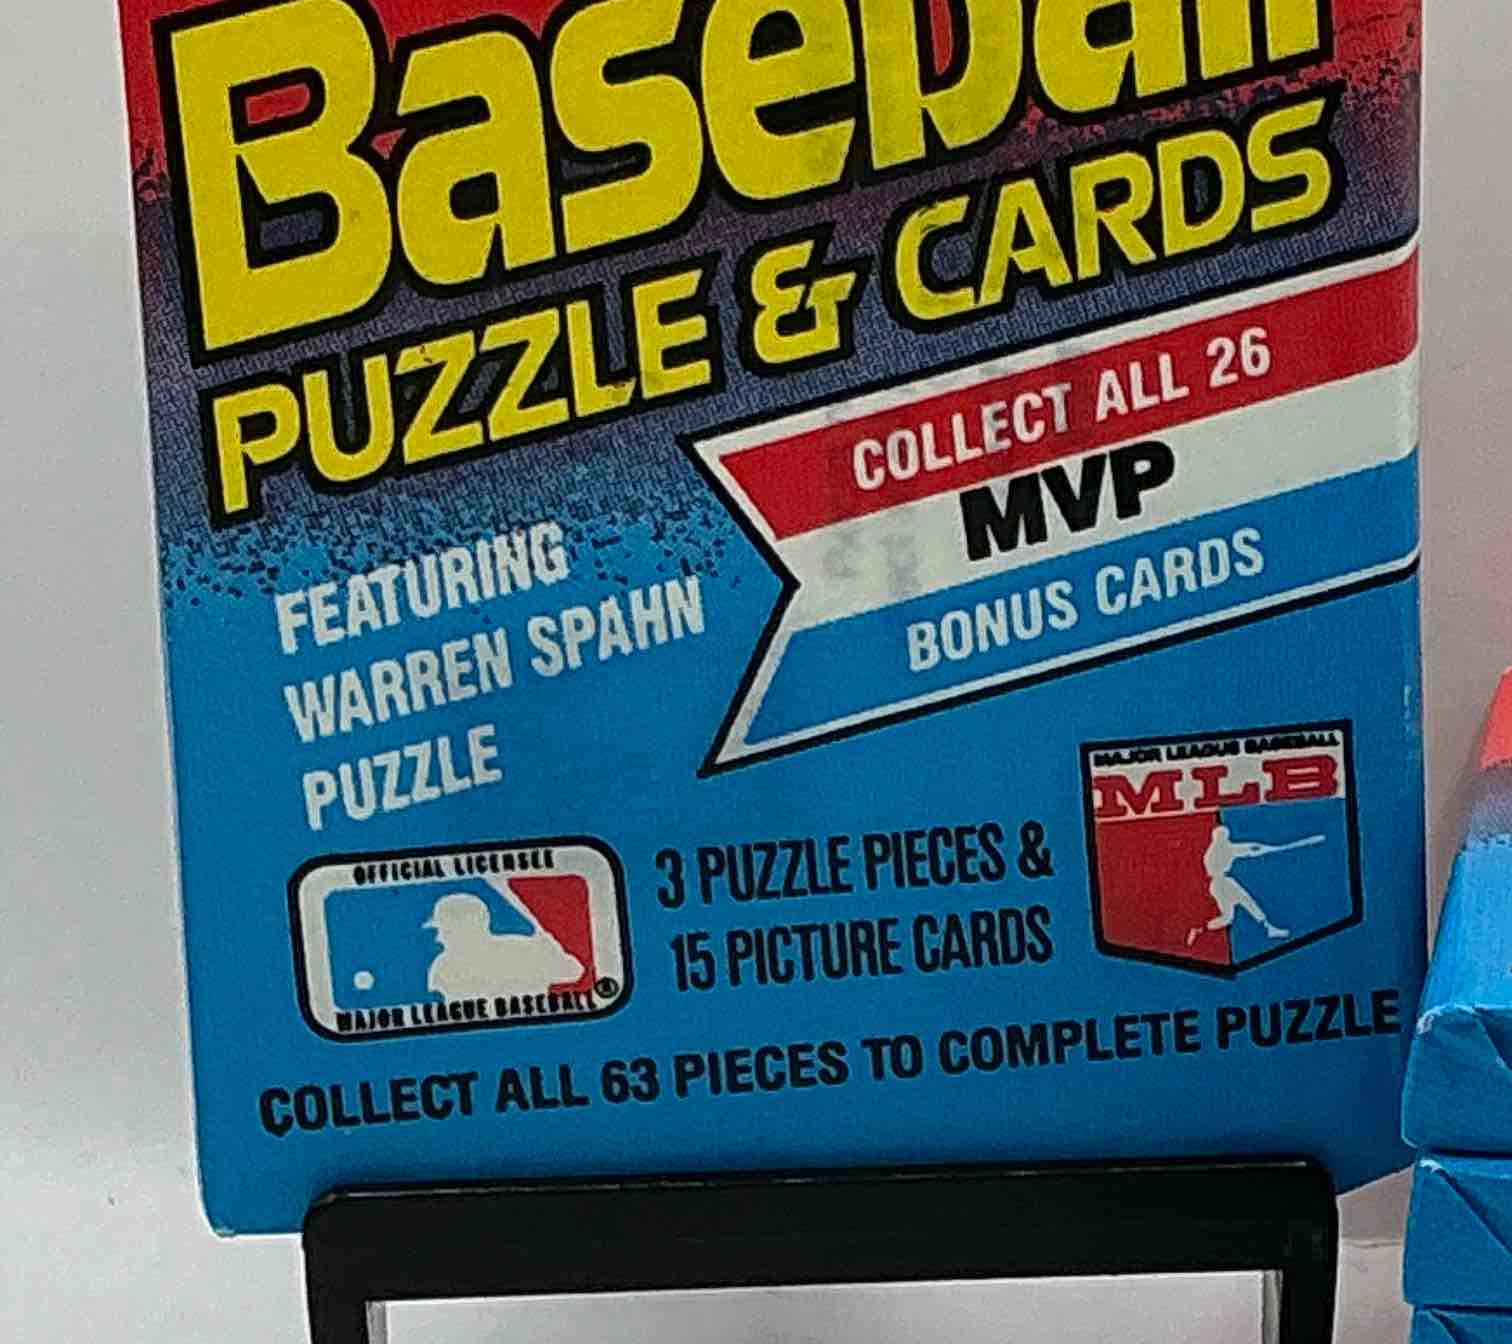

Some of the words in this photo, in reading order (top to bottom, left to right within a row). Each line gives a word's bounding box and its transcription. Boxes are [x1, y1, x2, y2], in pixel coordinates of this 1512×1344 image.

[195, 257, 725, 527] PUZZLE
[741, 224, 868, 373] &
[883, 89, 1347, 333] CARDS
[852, 381, 1072, 491] COLLECT
[1095, 351, 1189, 423] ALL
[1206, 326, 1271, 391] 26
[959, 439, 1176, 561] MVP
[275, 521, 570, 656] FEATURING
[906, 579, 1078, 673] BONUS
[1095, 527, 1265, 615] CARDS
[283, 627, 514, 744] WARREN
[526, 574, 705, 678] SPAHN
[304, 723, 502, 831] PUZZLE
[1094, 747, 1162, 766] MAJOR
[1166, 740, 1239, 760] LEAGUE
[1094, 753, 1338, 818] MLB
[352, 863, 444, 886] OFFICIAL
[454, 848, 556, 876] LICENSEE
[655, 847, 684, 909] 3
[702, 834, 851, 905] PUZZLE
[863, 822, 1003, 890] PIECES
[1017, 819, 1055, 879] &
[670, 930, 716, 993] 15
[727, 921, 904, 988] PICTURE
[912, 905, 1054, 974] CARDS
[258, 1072, 479, 1138] COLLECT
[494, 1064, 589, 1113] ALL
[601, 1058, 658, 1104] 63
[673, 1040, 850, 1098] PIECES
[862, 1034, 922, 1084] TO
[939, 1009, 1201, 1075] COMPLETE
[1216, 988, 1401, 1051] PUZZLE
[336, 1006, 405, 1033] MAJOR
[411, 996, 489, 1026] LEAGUE
[494, 986, 598, 1017] BASEBALL
